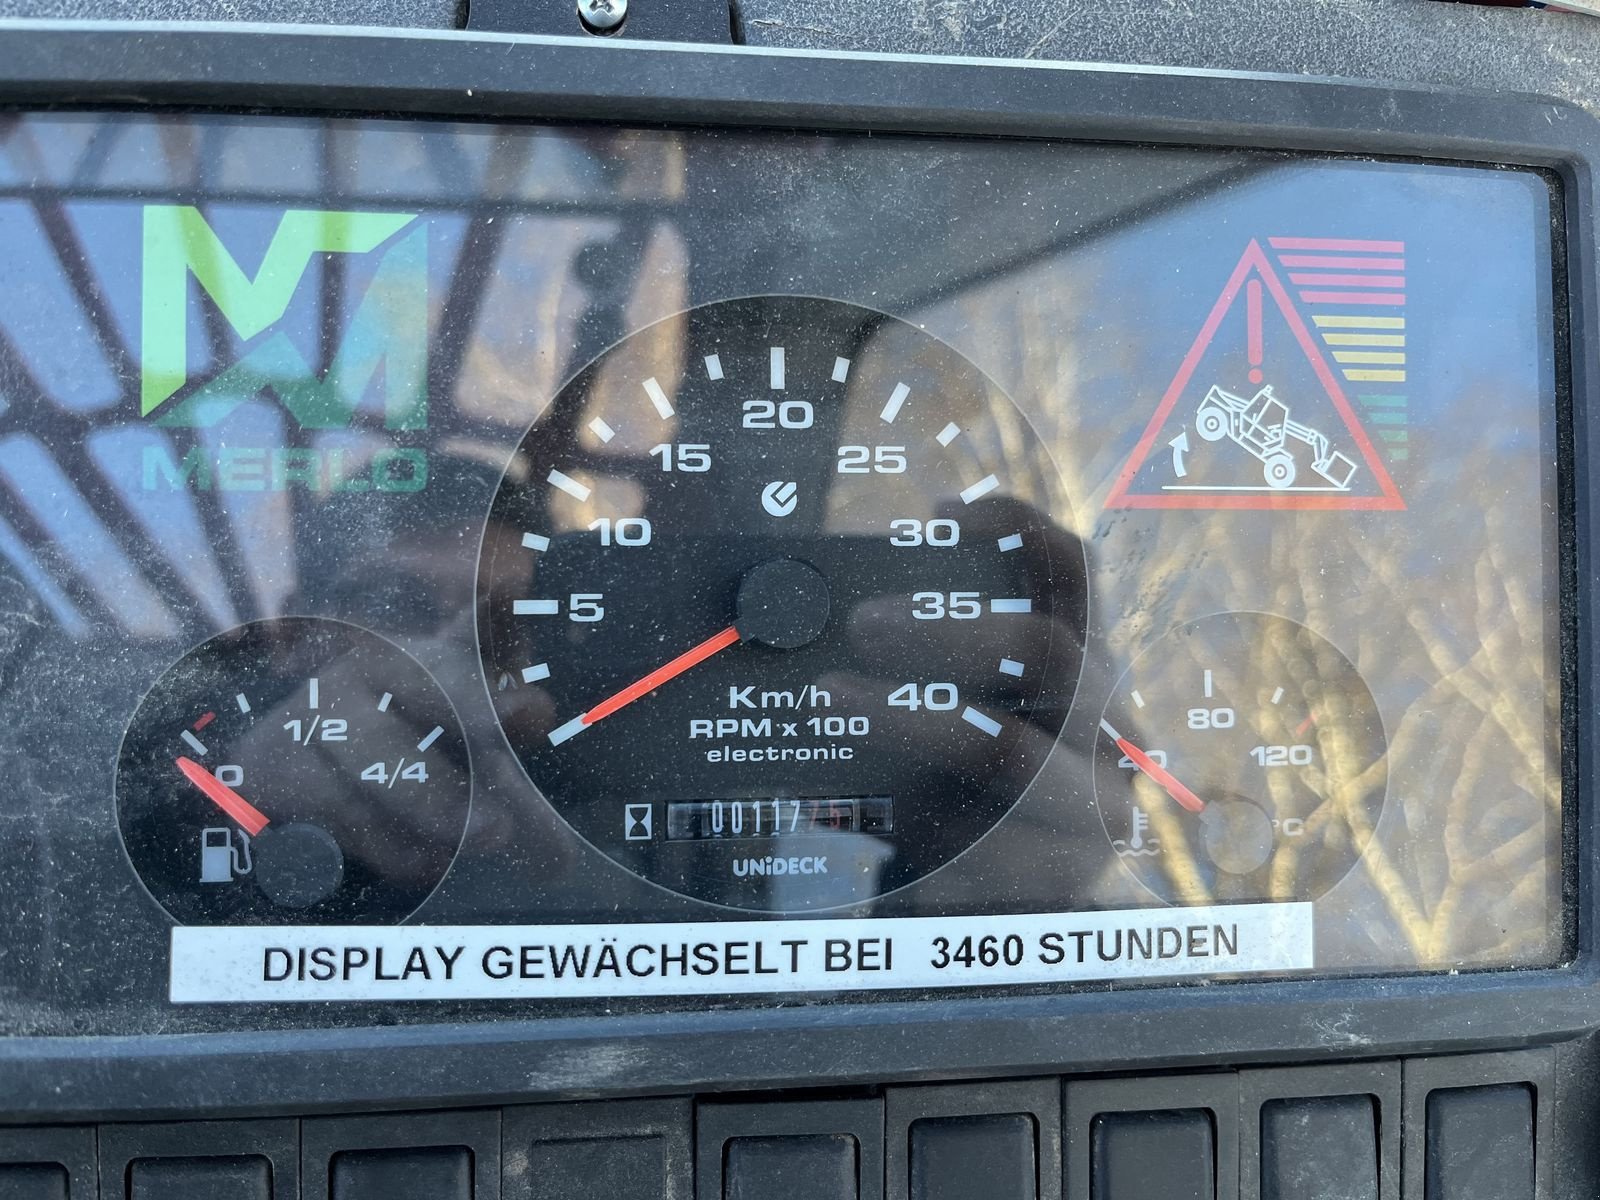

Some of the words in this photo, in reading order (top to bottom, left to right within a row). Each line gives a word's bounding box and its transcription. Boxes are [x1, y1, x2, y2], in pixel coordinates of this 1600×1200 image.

[742, 400, 814, 429] 20
[142, 447, 429, 493] MERLO
[649, 443, 712, 473] 15
[837, 445, 907, 474] 25
[588, 517, 652, 547] 10
[889, 518, 960, 547] 30
[569, 593, 605, 623] 5
[911, 591, 982, 620] 35
[728, 685, 832, 710] Km/h
[887, 682, 959, 711] 40
[283, 715, 348, 746] 1/2
[689, 717, 772, 739] RPM
[806, 716, 870, 736] 100
[1187, 707, 1235, 729] 80
[706, 744, 854, 763] electronic
[1250, 744, 1313, 766] 120
[360, 757, 429, 789] 4/4
[263, 945, 465, 982] DISPLAY
[481, 937, 808, 979] GEWÄCHSELT
[825, 937, 893, 973] BEI
[930, 934, 1025, 969] 3460
[1038, 923, 1240, 965] STUNDEN
